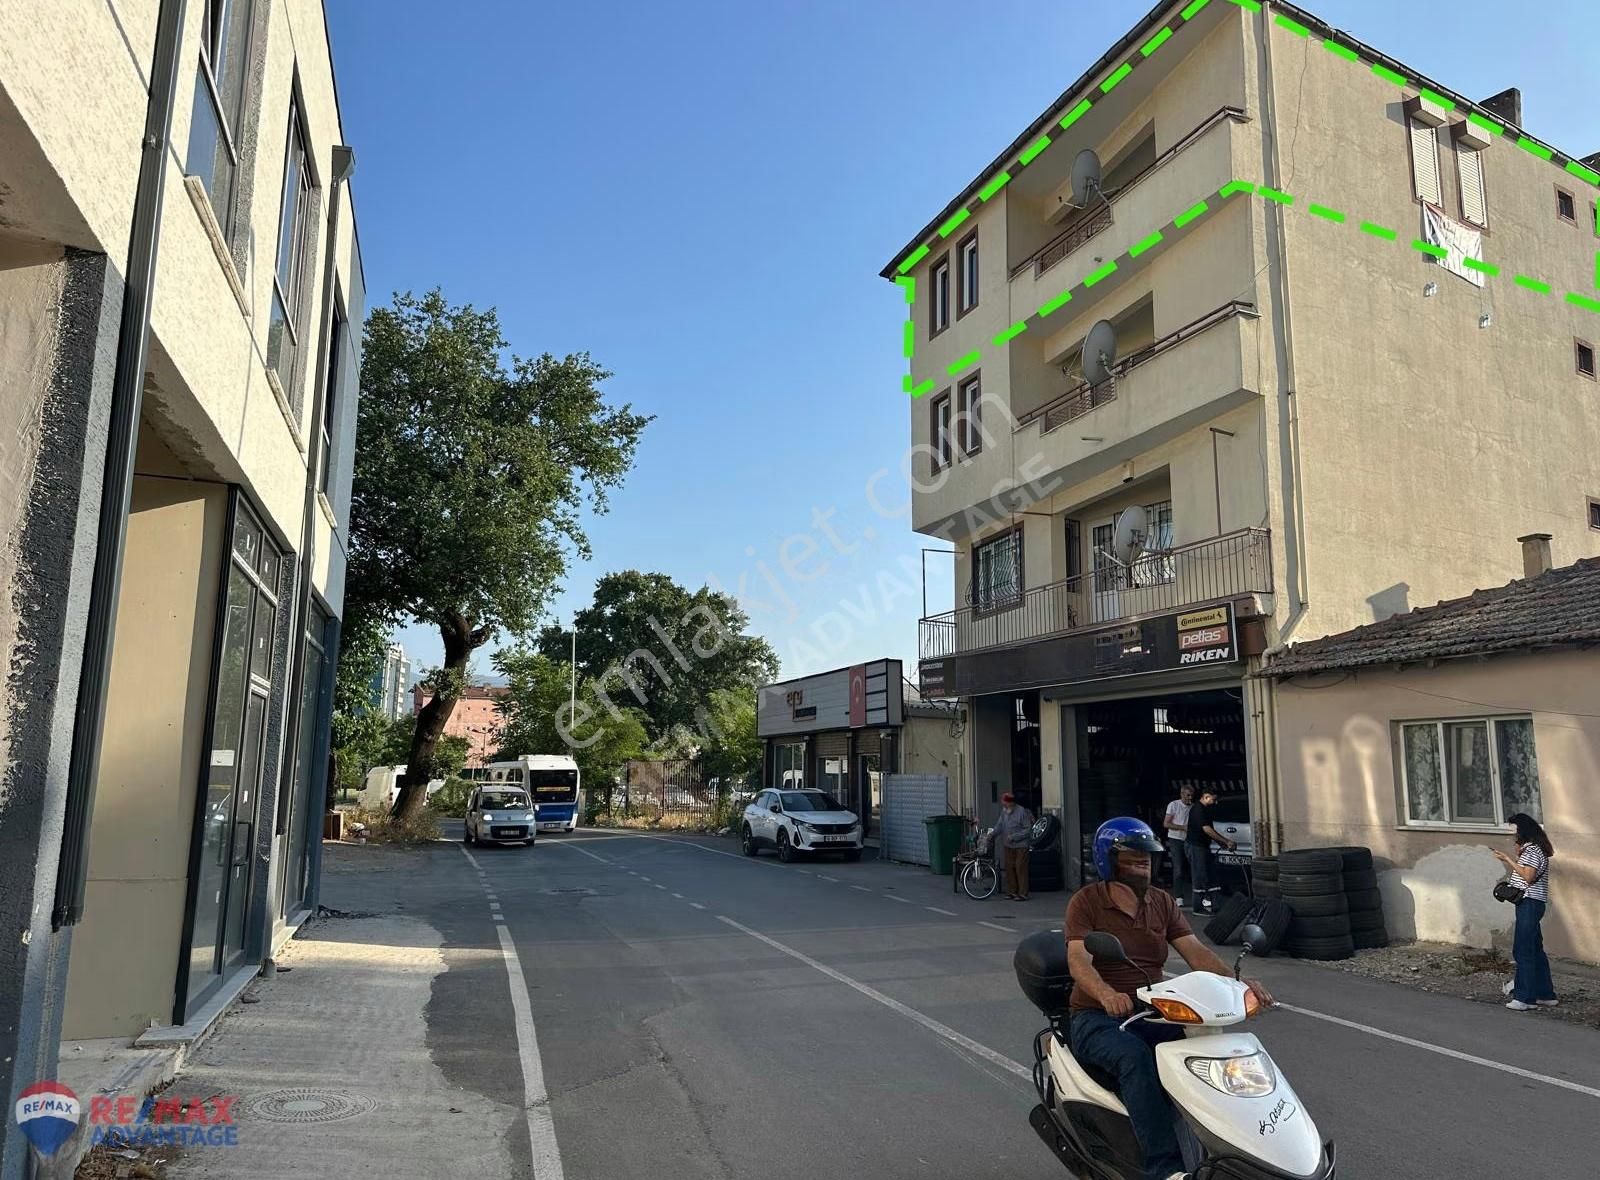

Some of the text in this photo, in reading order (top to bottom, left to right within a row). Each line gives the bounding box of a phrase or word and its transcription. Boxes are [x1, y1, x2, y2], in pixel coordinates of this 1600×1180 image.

[1181, 613, 1216, 627] Continental
[1182, 629, 1222, 649] petlas
[1180, 647, 1230, 664] RIKEN
